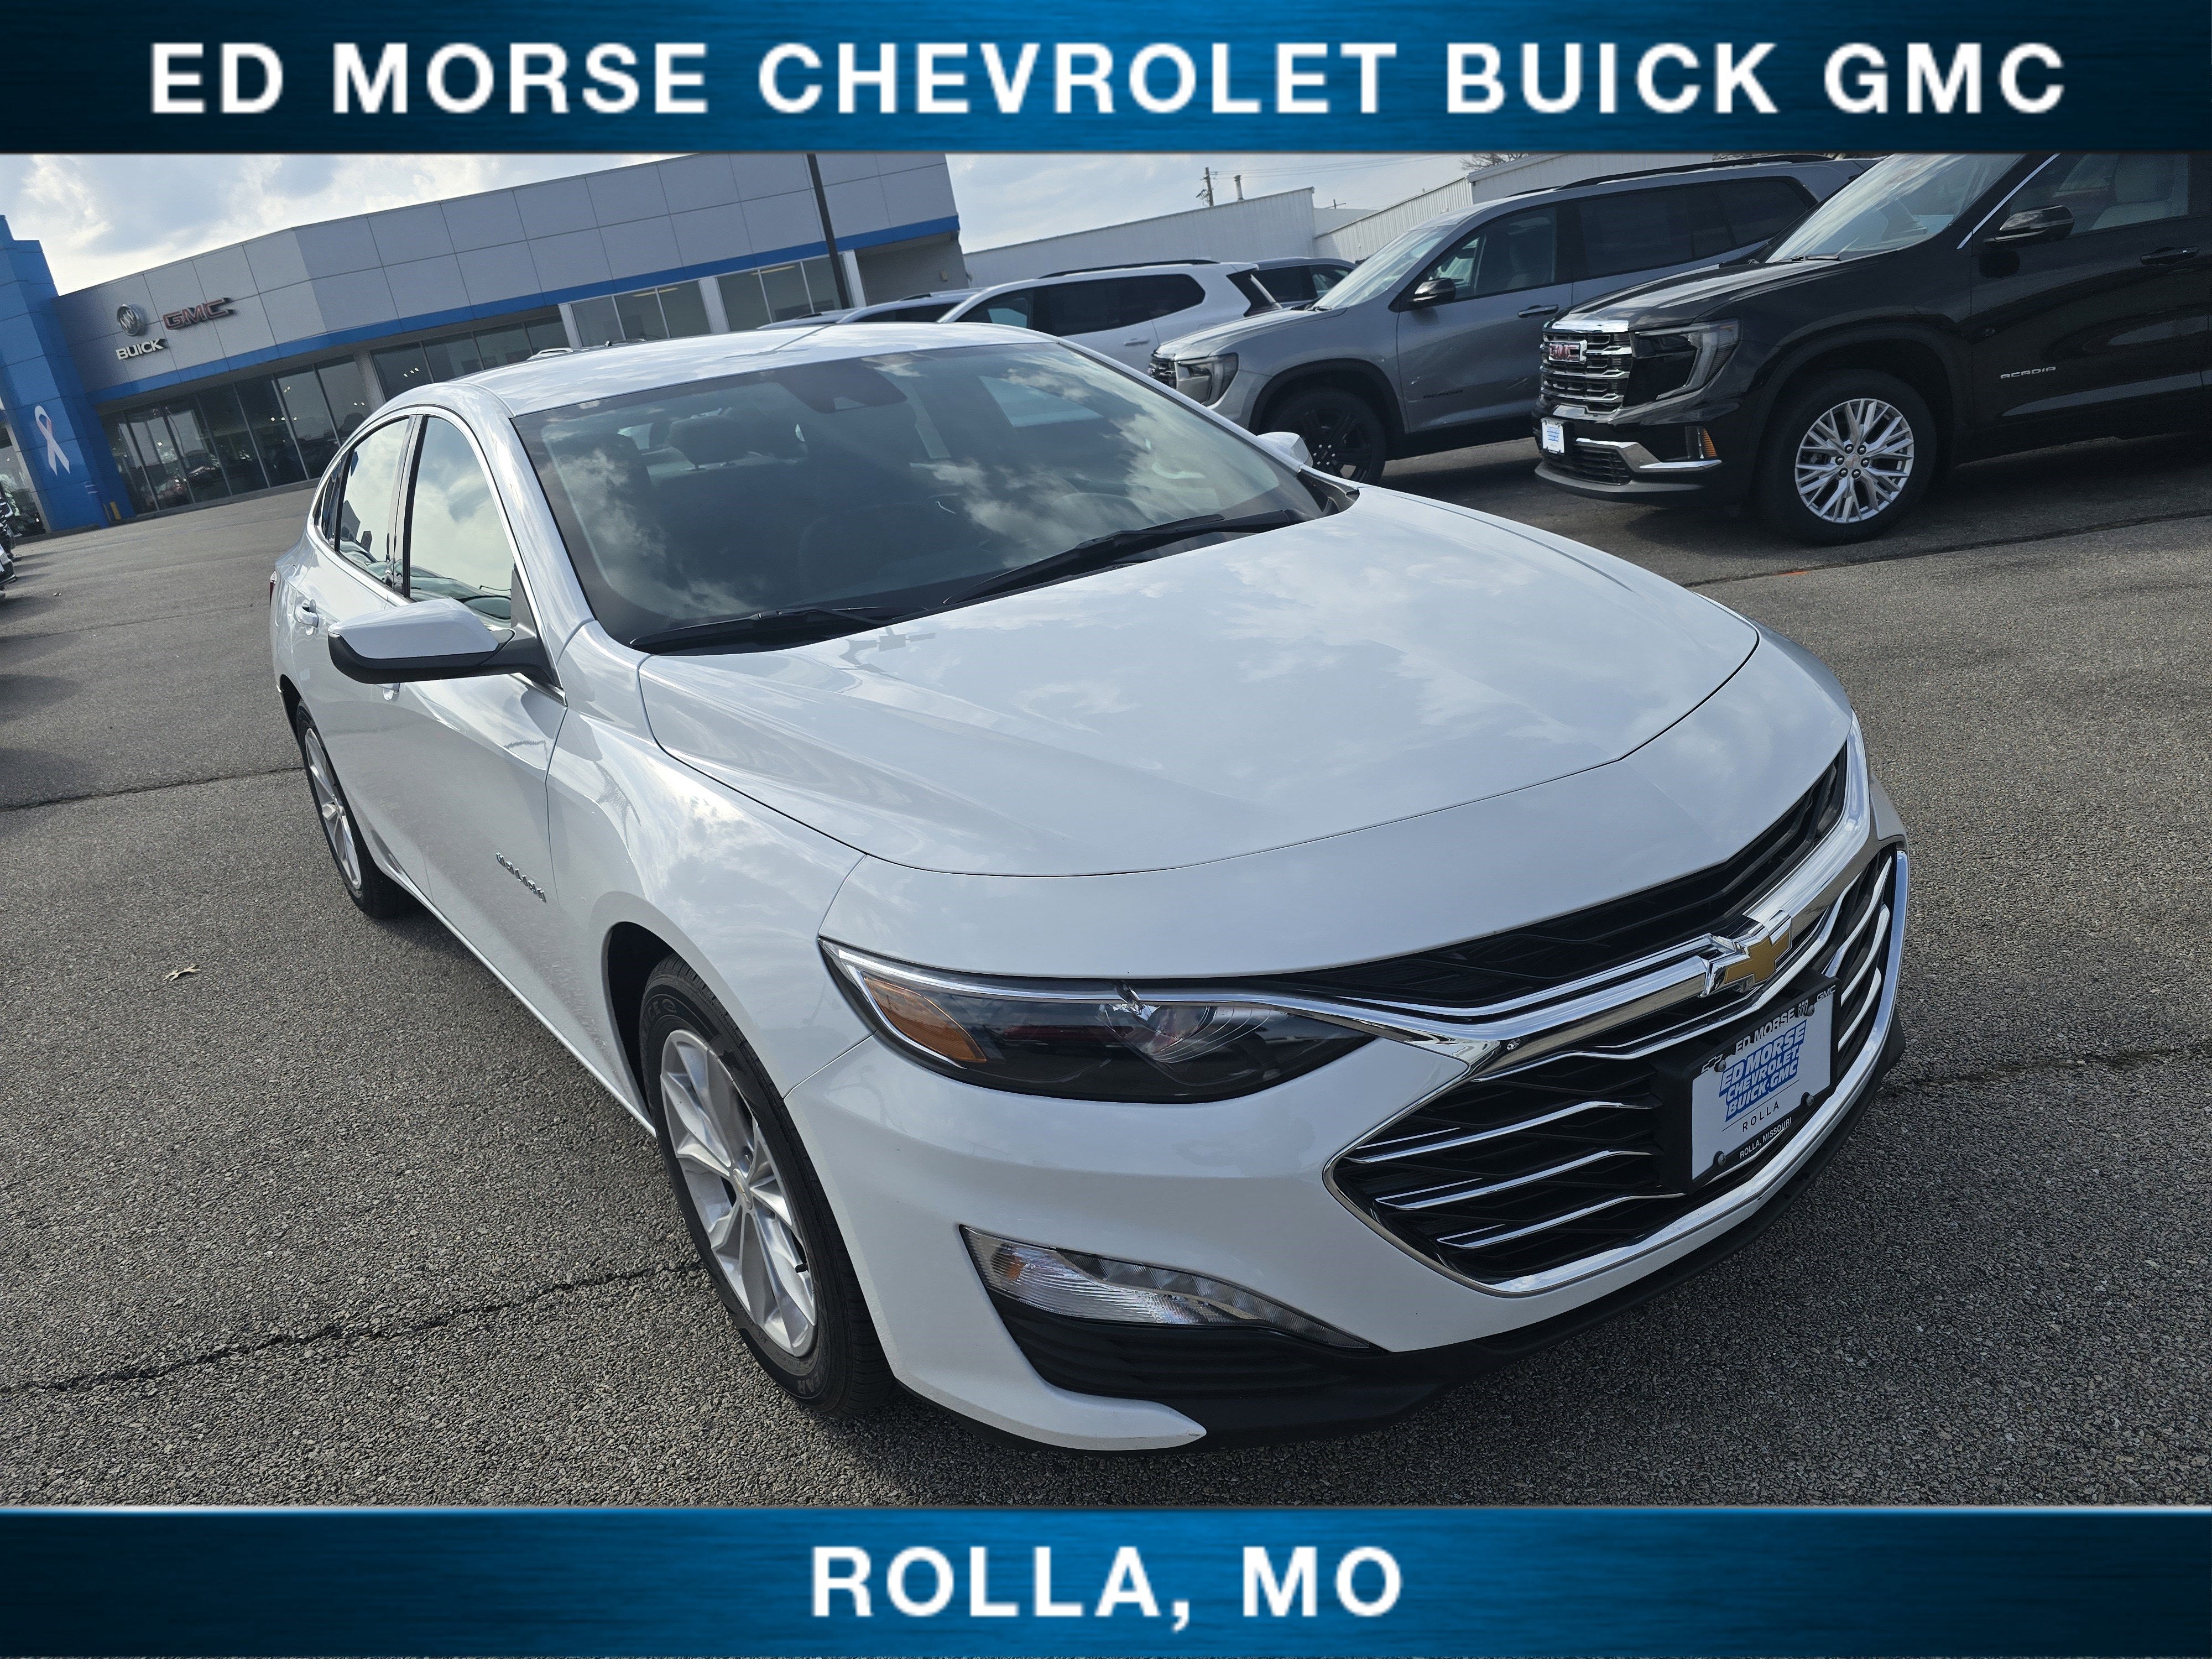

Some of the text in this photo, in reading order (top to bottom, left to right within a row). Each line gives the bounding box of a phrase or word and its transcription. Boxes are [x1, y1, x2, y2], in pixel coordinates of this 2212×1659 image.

[163, 298, 228, 330] GMC
[116, 338, 164, 359] BUICK
[2000, 366, 2057, 379] ACADIA
[1817, 984, 1837, 1002] GMC
[1735, 1007, 1796, 1055] ED MORSE
[1720, 1021, 1807, 1092] ED MORSE
[1726, 1044, 1799, 1103] CHEVROLET
[1743, 1101, 1780, 1133] ROLLA
[1739, 1117, 1792, 1159] ROLLA, MISSOURI
